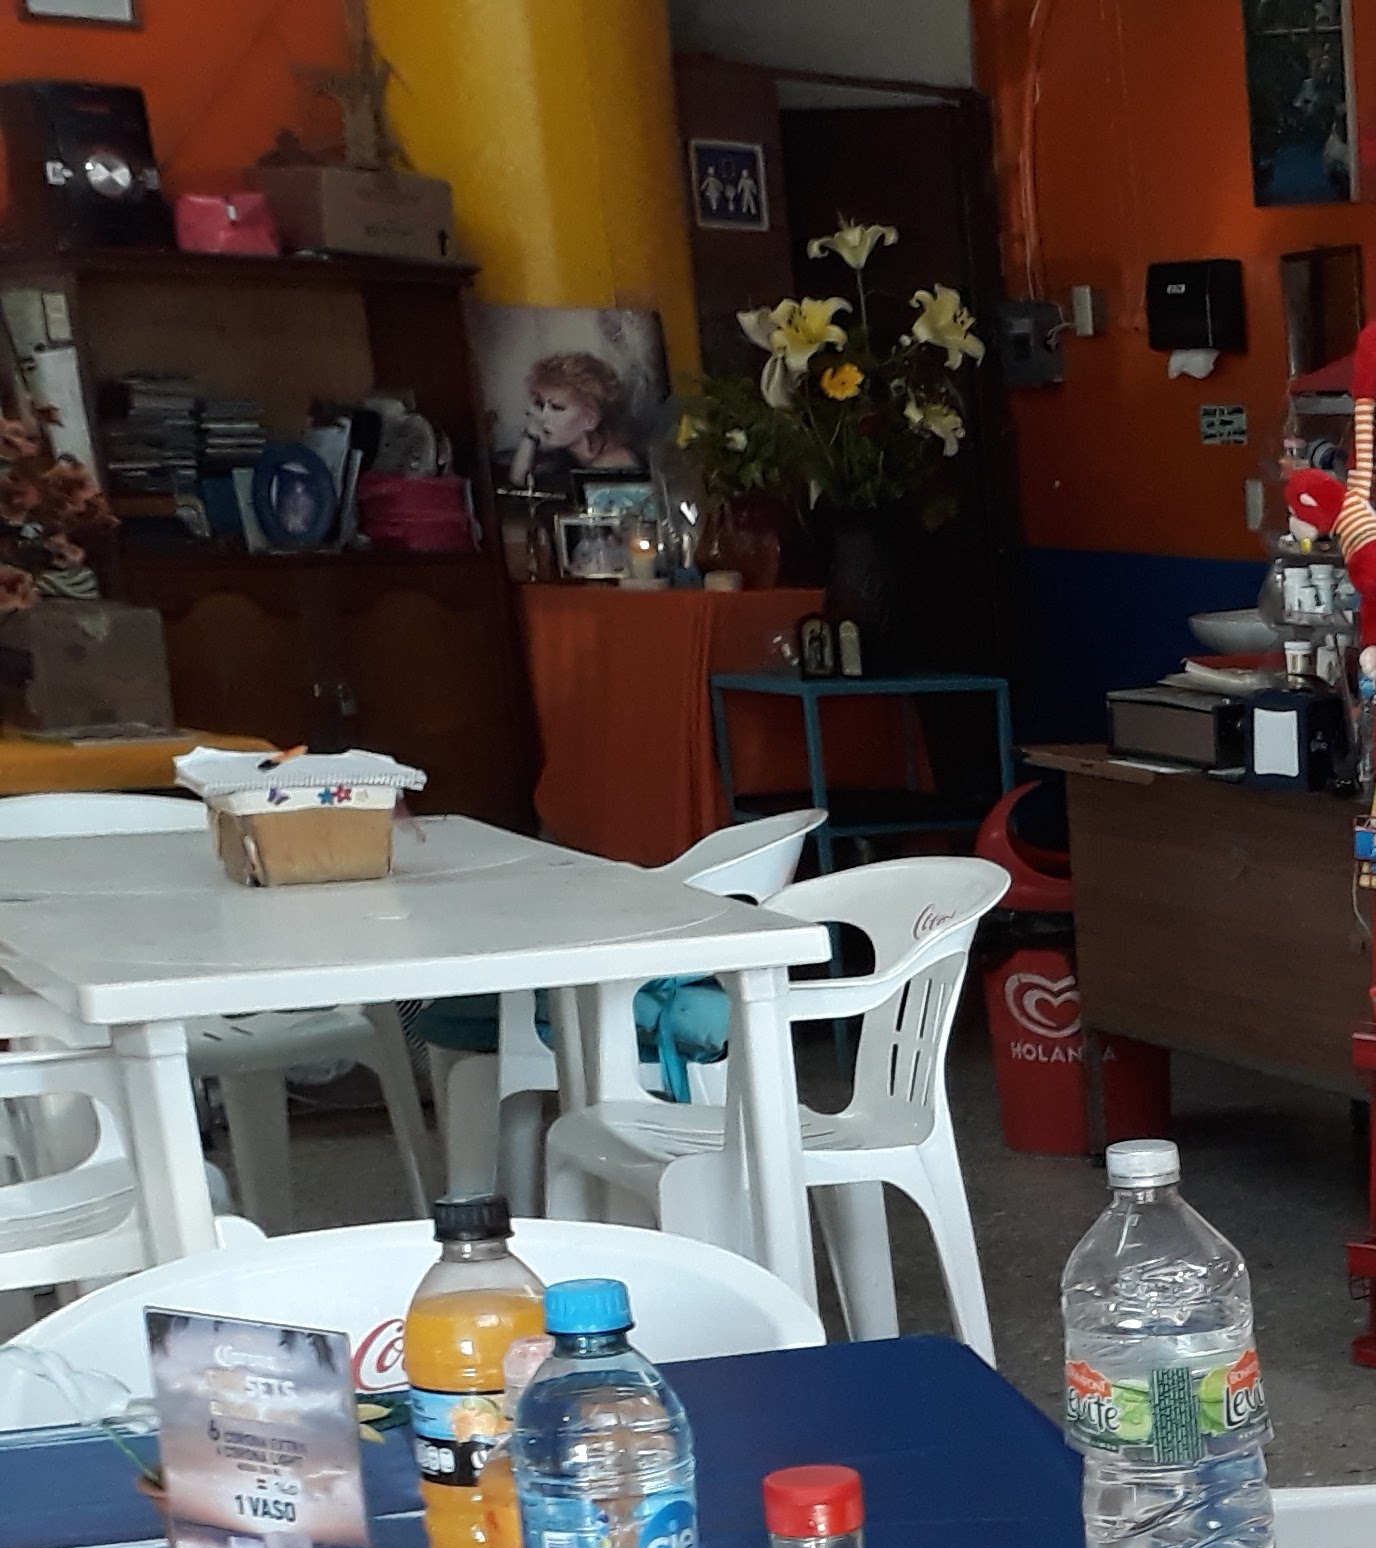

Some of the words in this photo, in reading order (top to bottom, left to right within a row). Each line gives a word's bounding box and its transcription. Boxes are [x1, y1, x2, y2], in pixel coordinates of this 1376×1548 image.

[1010, 1042, 1115, 1063] HOLANA
[234, 1494, 245, 1516] 1
[247, 1496, 297, 1523] VASO
